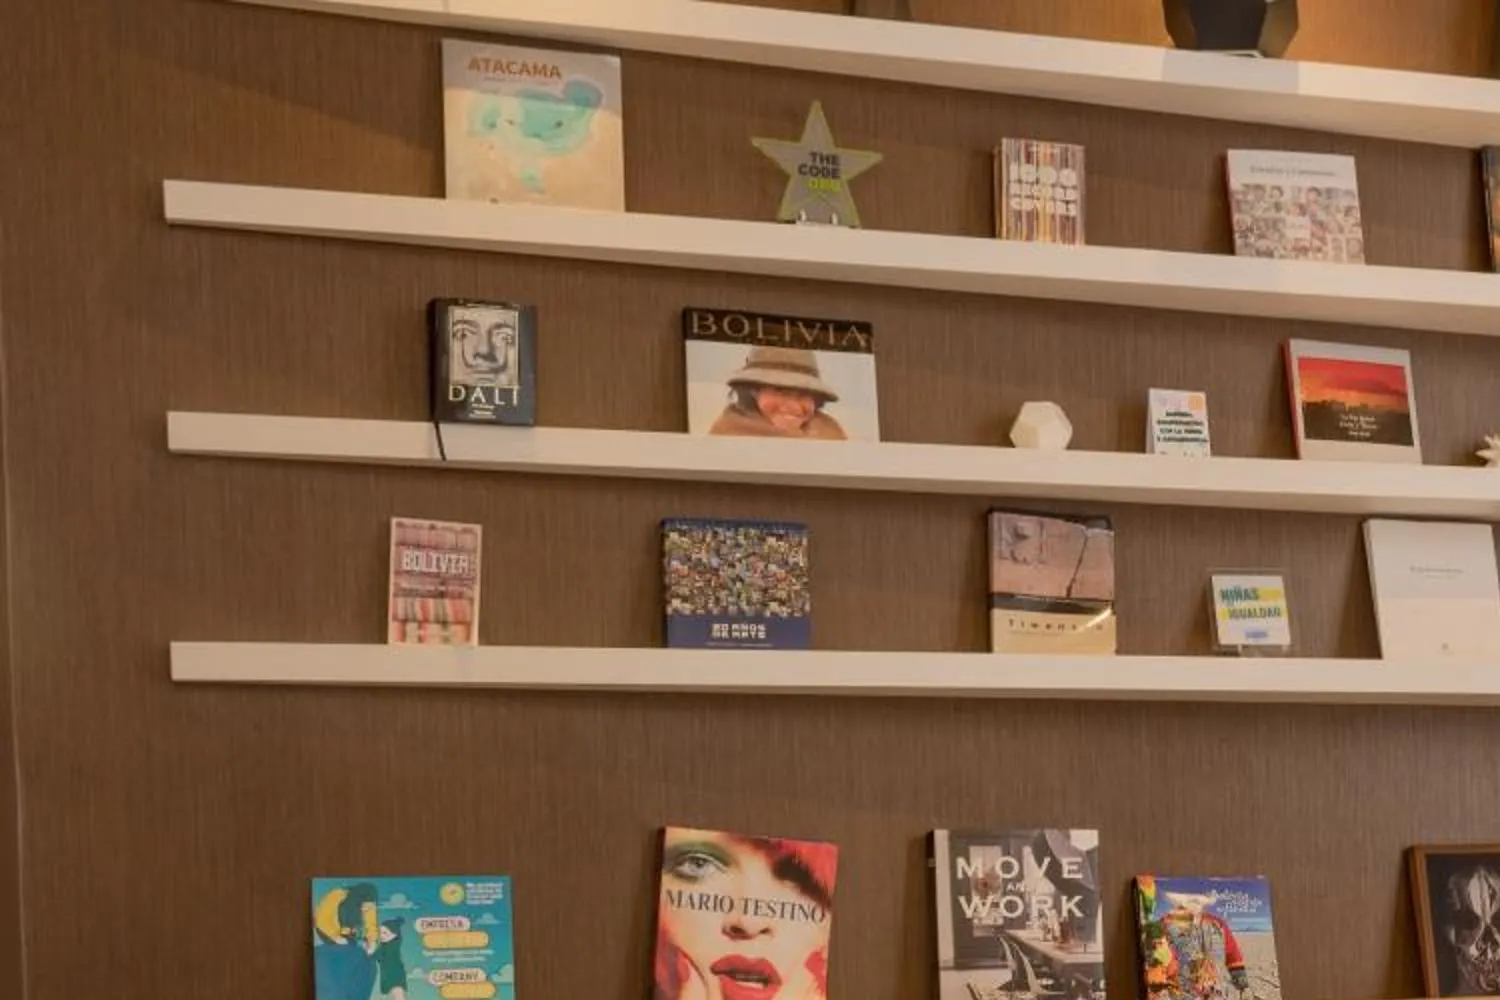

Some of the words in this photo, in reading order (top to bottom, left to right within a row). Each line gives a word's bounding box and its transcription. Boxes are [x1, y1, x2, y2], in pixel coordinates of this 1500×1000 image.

[467, 56, 562, 80] ATACAMA
[809, 151, 840, 166] THE
[798, 163, 841, 179] CODE
[691, 311, 868, 349] BOLIVIA
[401, 547, 470, 575] BOLIVIA
[956, 856, 1084, 880] MOVE
[664, 889, 734, 914] MARIO
[743, 897, 826, 923] TESTINO
[959, 895, 1085, 920] WORK
